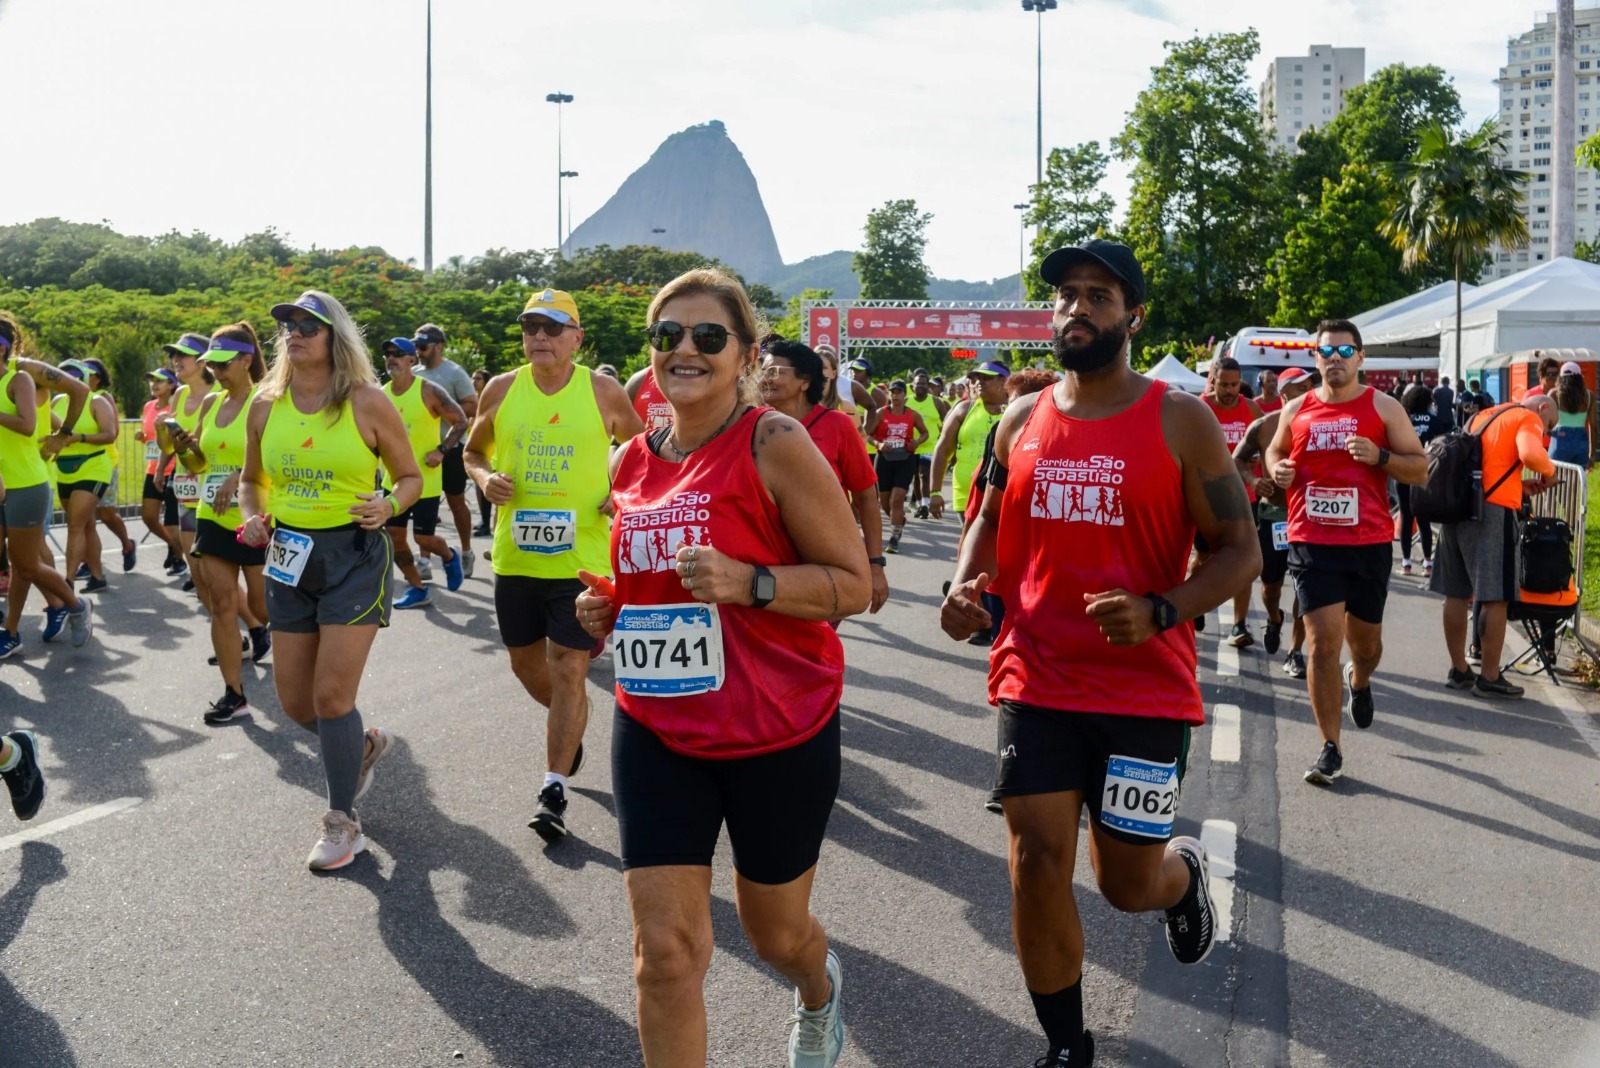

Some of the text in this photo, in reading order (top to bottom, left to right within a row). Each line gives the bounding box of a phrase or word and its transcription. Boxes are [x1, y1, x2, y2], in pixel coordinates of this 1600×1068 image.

[530, 430, 544, 443] SE
[528, 444, 574, 457] CUIDAR
[281, 453, 296, 466] SE
[527, 458, 569, 471] VALE A
[1035, 455, 1125, 470] Corrida de São
[282, 467, 334, 481] CUIDAR
[525, 471, 559, 484] PENA
[1033, 467, 1124, 484] Sebastião
[287, 483, 319, 499] PENA
[322, 482, 331, 491] A
[672, 490, 711, 507] São
[1311, 499, 1350, 515] 2207
[620, 505, 710, 530] Sebastião
[518, 525, 567, 543] 7767
[650, 613, 670, 621] São
[624, 620, 670, 629] Sebastião
[615, 636, 709, 669] 10741
[1123, 769, 1168, 783] Sebastião
[1151, 768, 1169, 777] São
